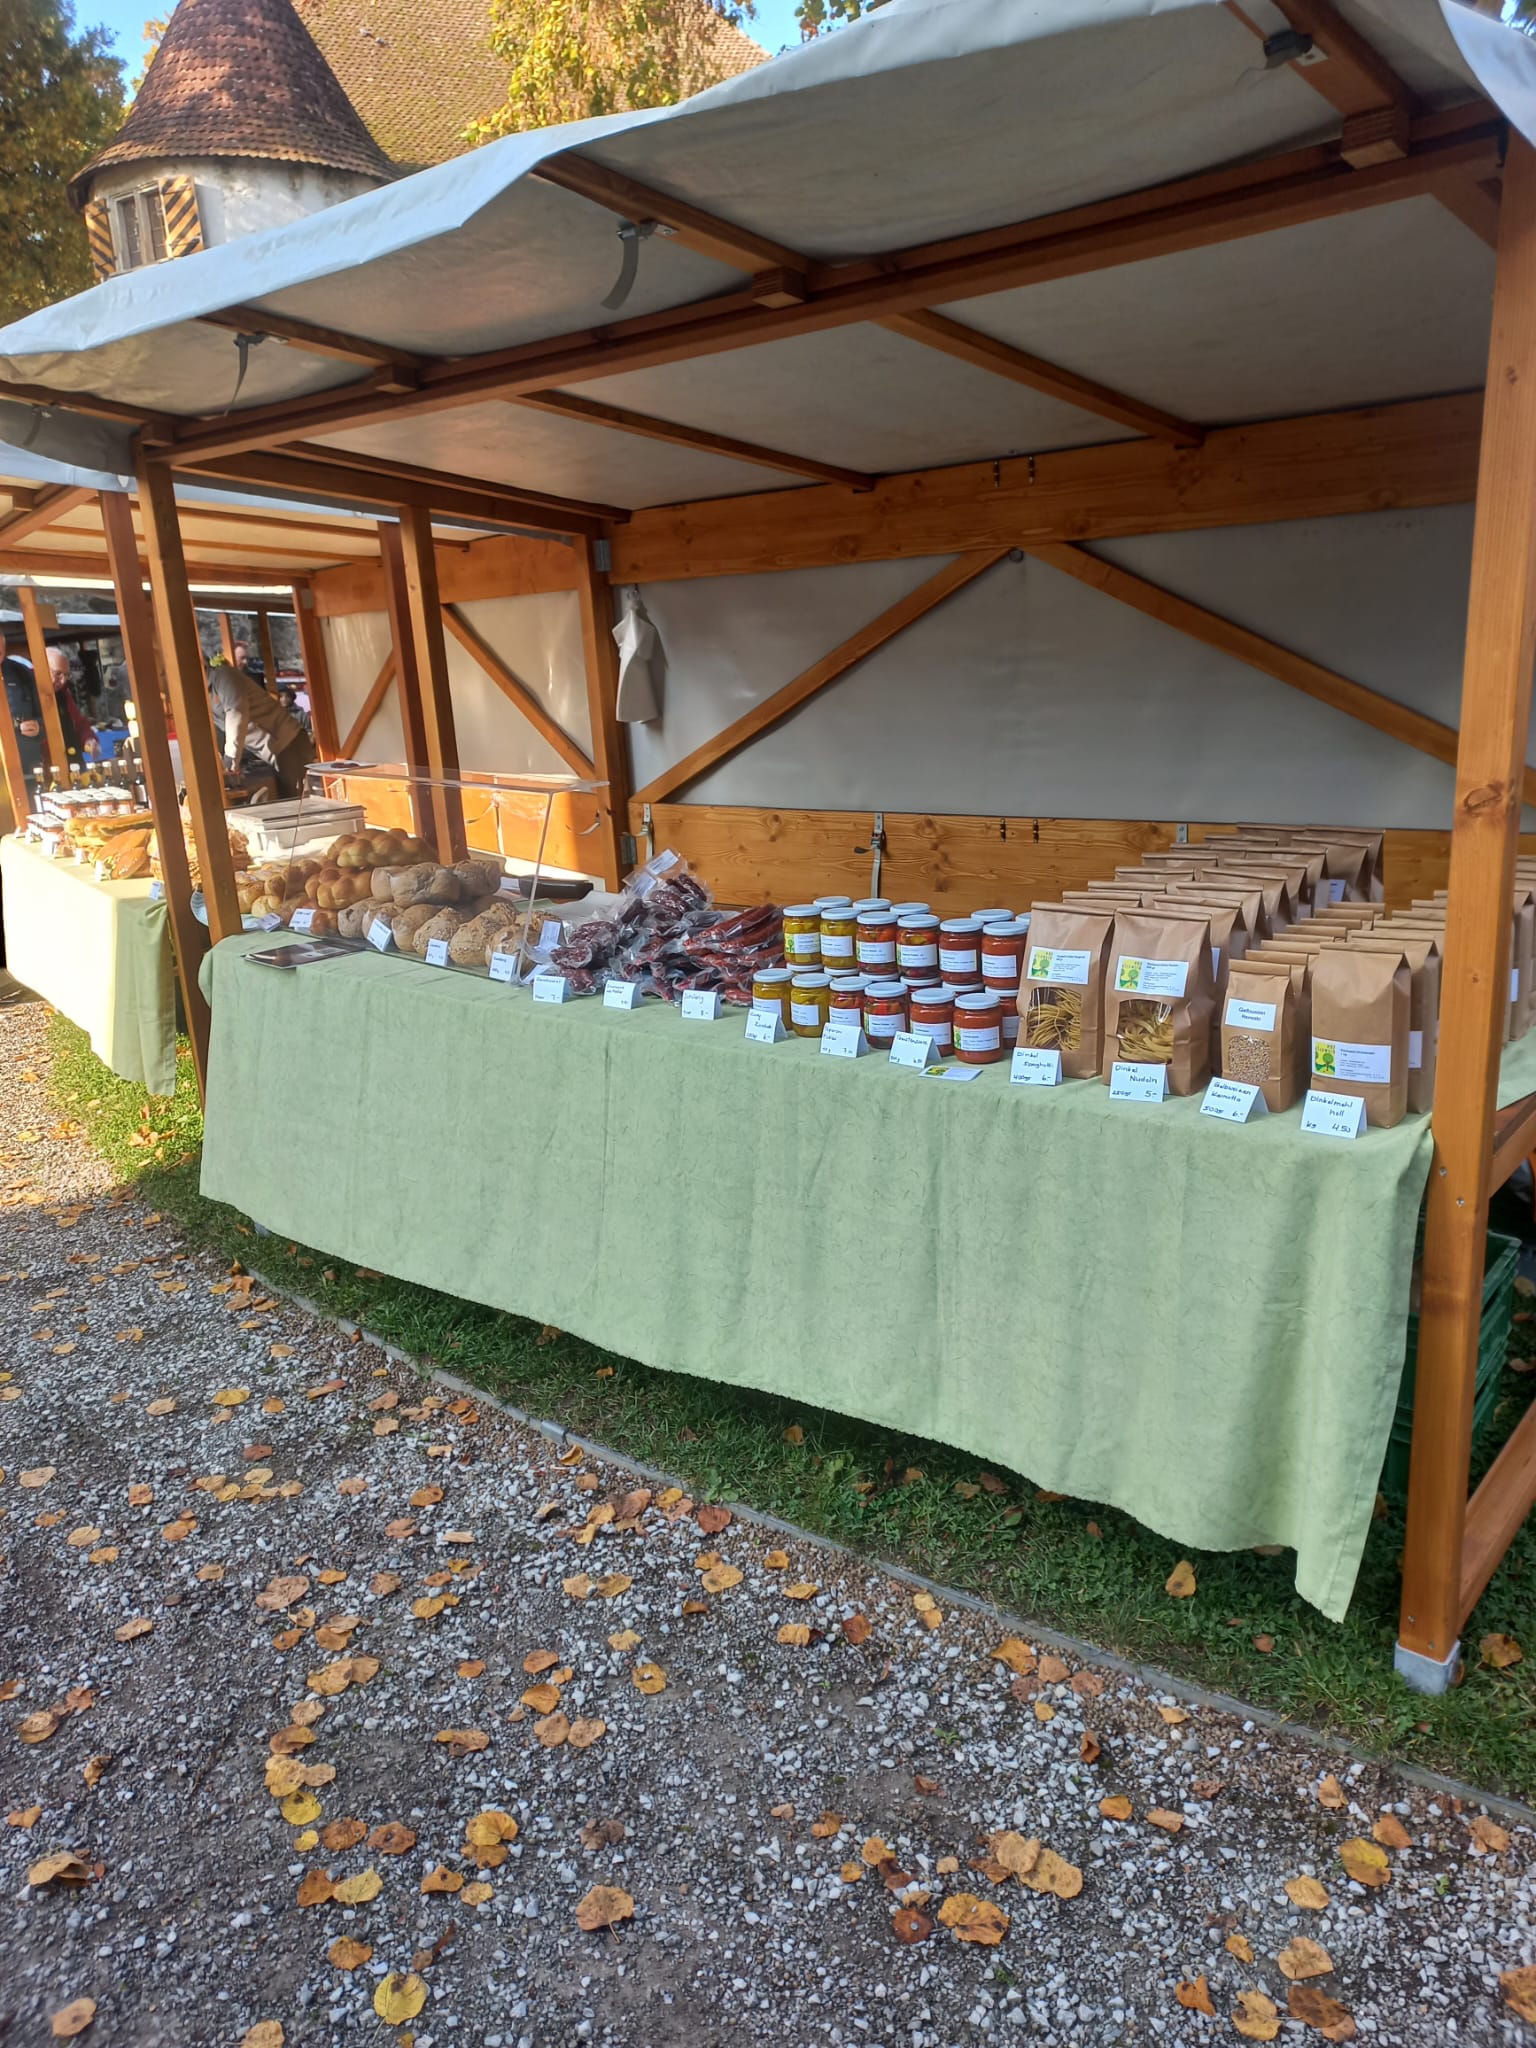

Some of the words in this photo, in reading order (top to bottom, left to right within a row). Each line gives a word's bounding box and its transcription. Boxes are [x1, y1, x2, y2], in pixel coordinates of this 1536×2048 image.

[1114, 1064, 1138, 1073] Dinkel
[1129, 1075, 1158, 1085] Nudeln
[1310, 1095, 1354, 1108] Dinkelmehl
[1329, 1109, 1345, 1117] hell
